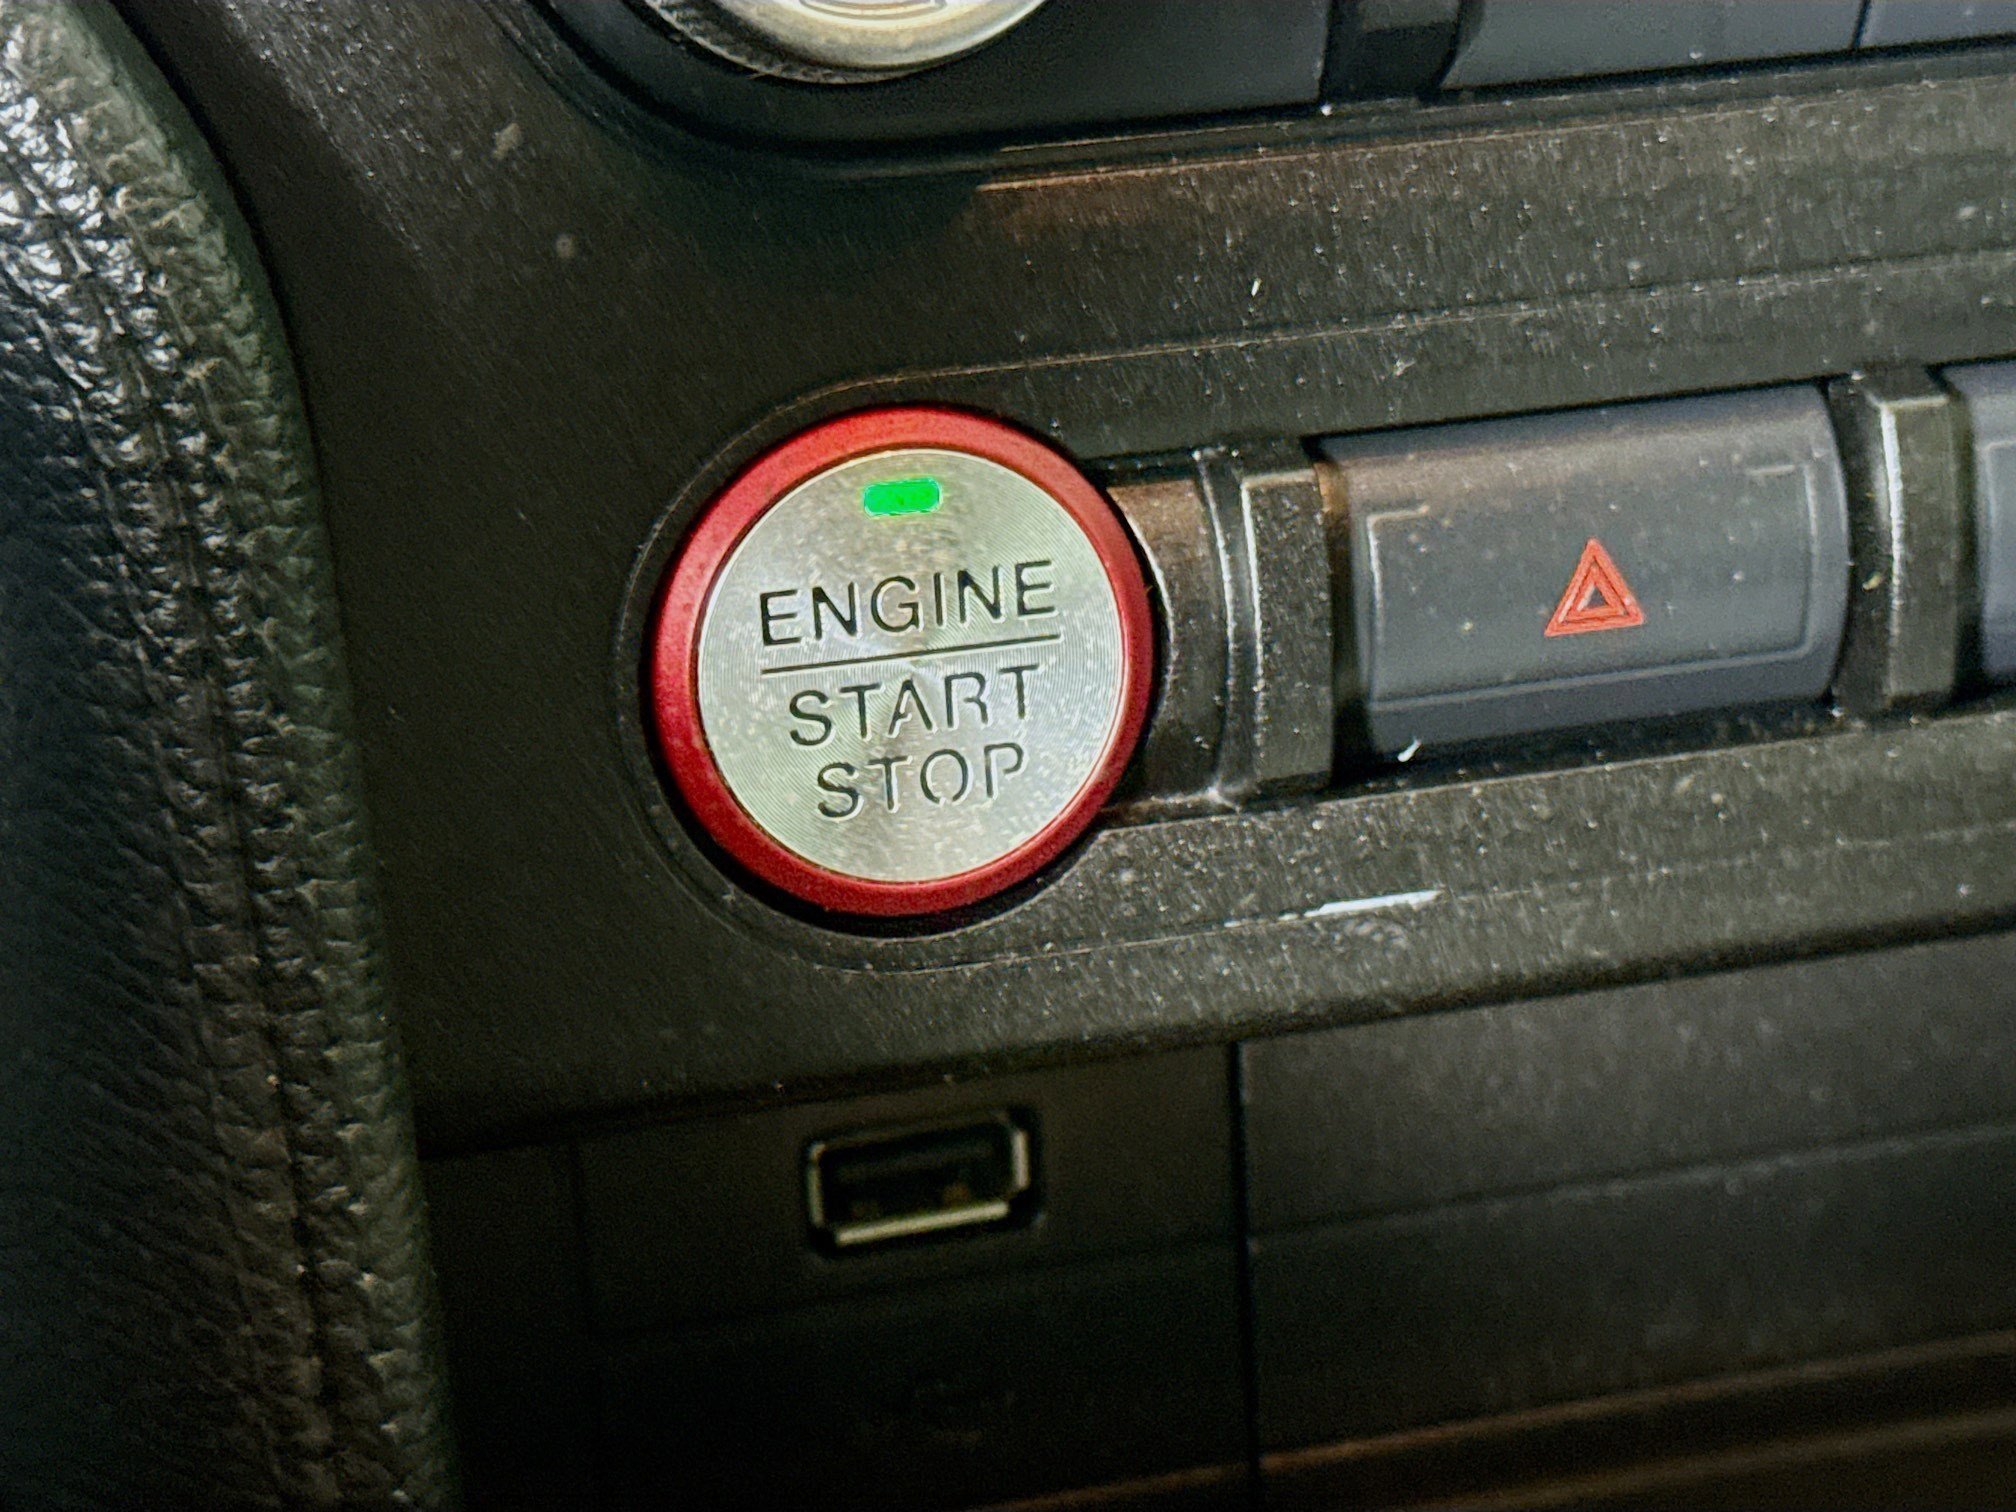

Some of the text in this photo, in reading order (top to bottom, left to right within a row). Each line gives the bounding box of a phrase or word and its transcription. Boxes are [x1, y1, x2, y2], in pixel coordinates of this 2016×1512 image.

[759, 559, 1057, 646] ENGINE
[788, 663, 1041, 748] START
[816, 741, 1026, 820] STOP
